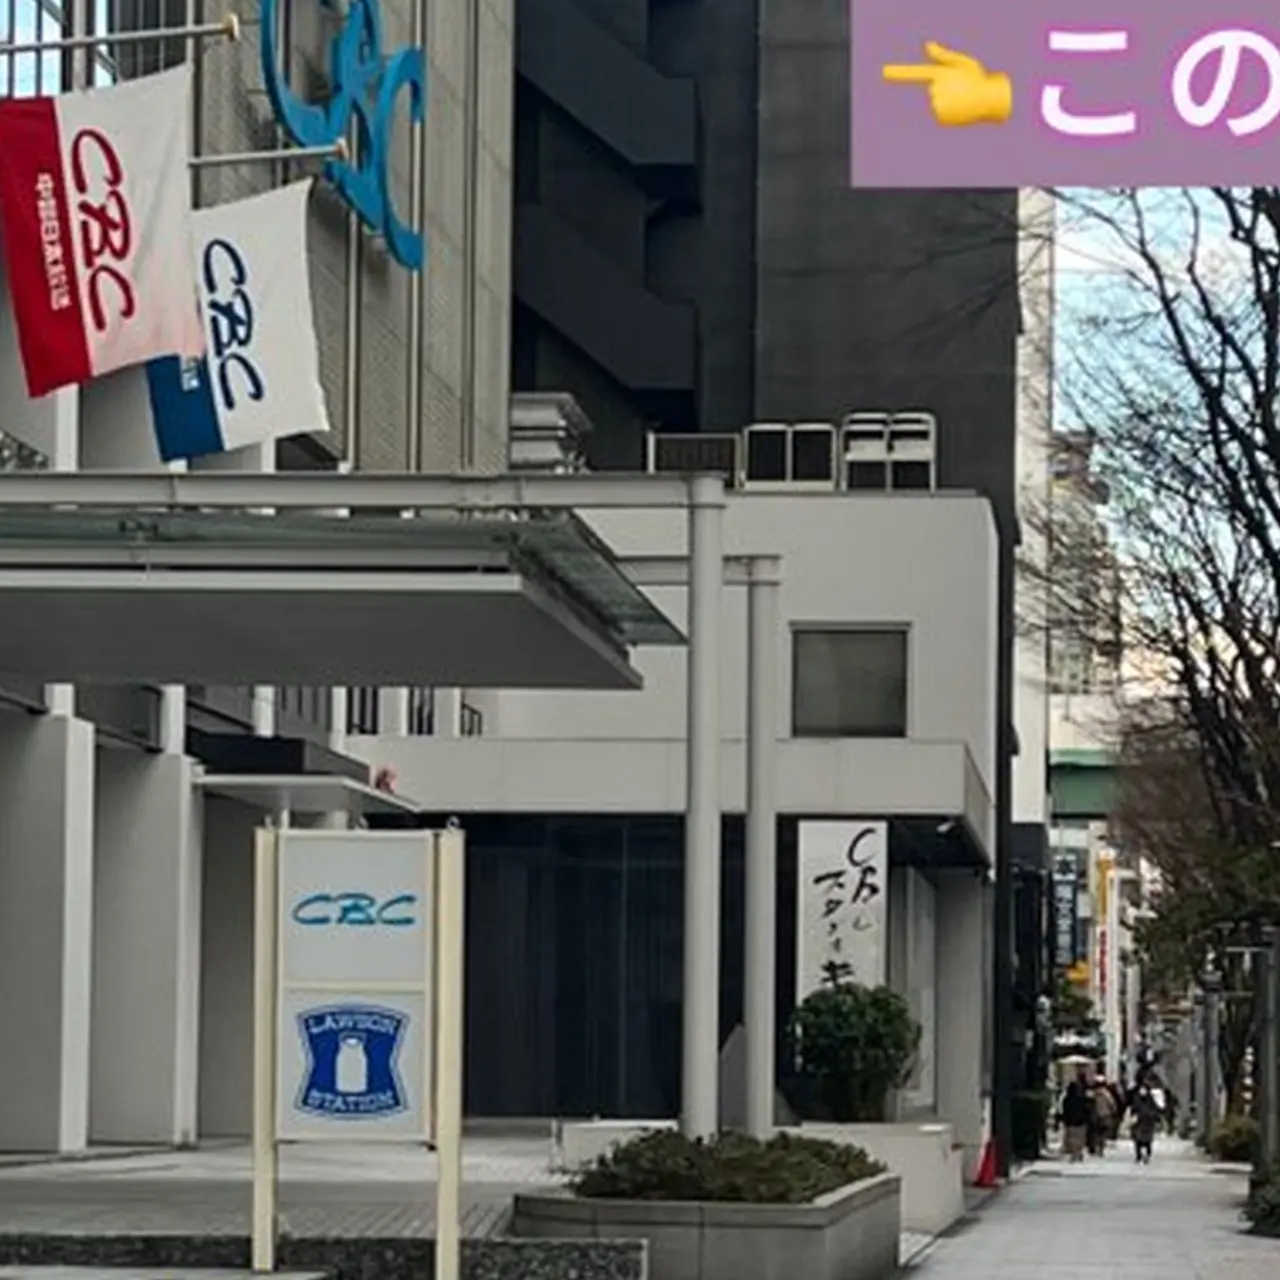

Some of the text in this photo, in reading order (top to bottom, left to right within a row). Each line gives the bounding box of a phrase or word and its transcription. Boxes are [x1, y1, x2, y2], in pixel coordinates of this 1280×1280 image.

[71, 127, 136, 332] CBC
[202, 238, 265, 411] CBC
[291, 892, 418, 926] CBC
